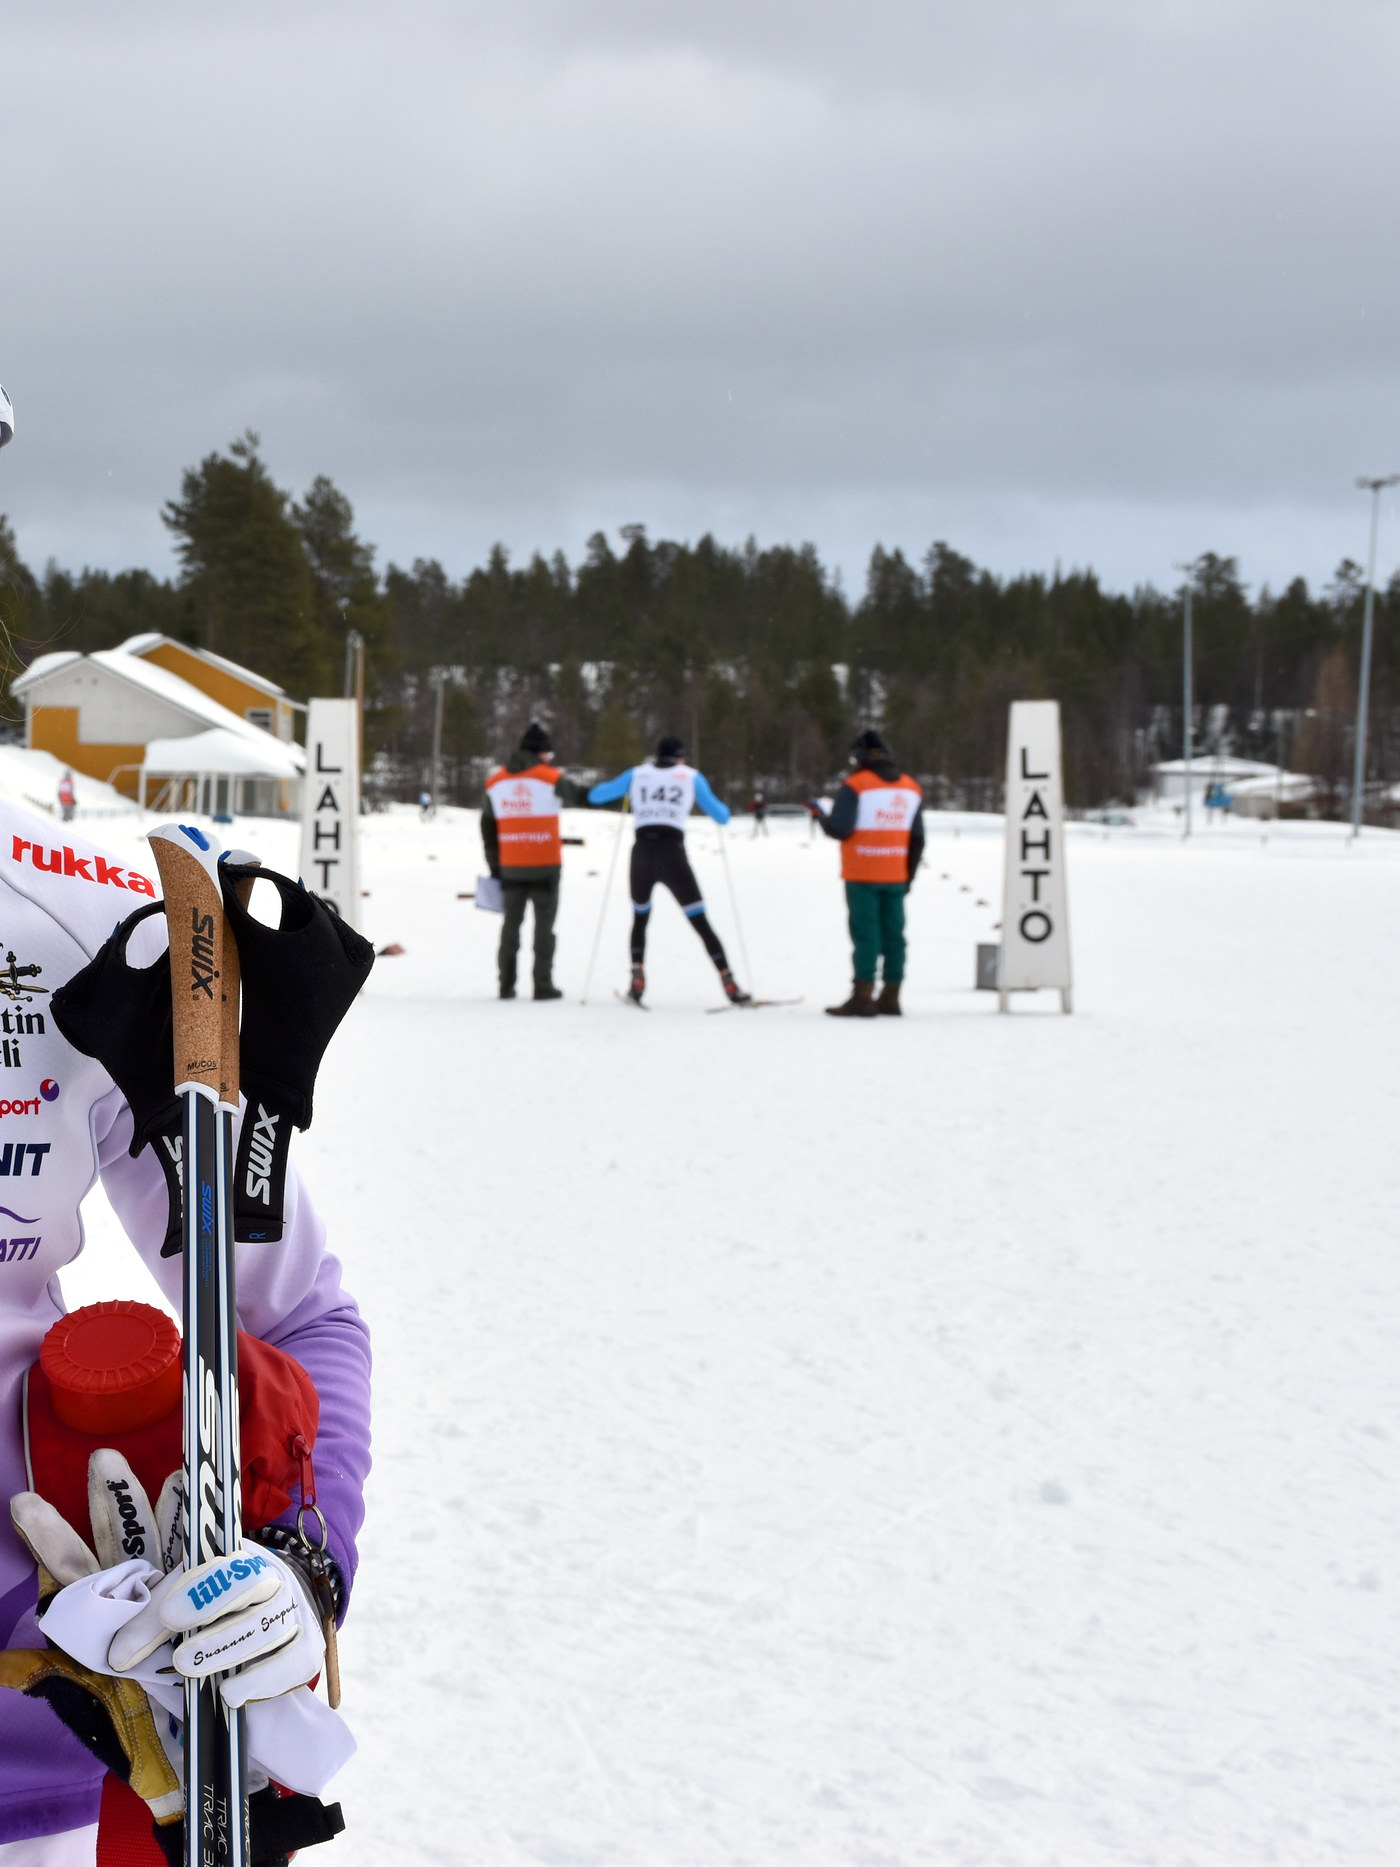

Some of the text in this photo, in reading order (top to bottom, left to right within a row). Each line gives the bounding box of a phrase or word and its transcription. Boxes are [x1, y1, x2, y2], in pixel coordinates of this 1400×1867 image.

[641, 785, 683, 806] 142
[12, 835, 156, 899] rukka
[193, 1629, 256, 1666] Susanna
[203, 1783, 214, 1841] TRIAC
[216, 1797, 228, 1855] TRIAC
